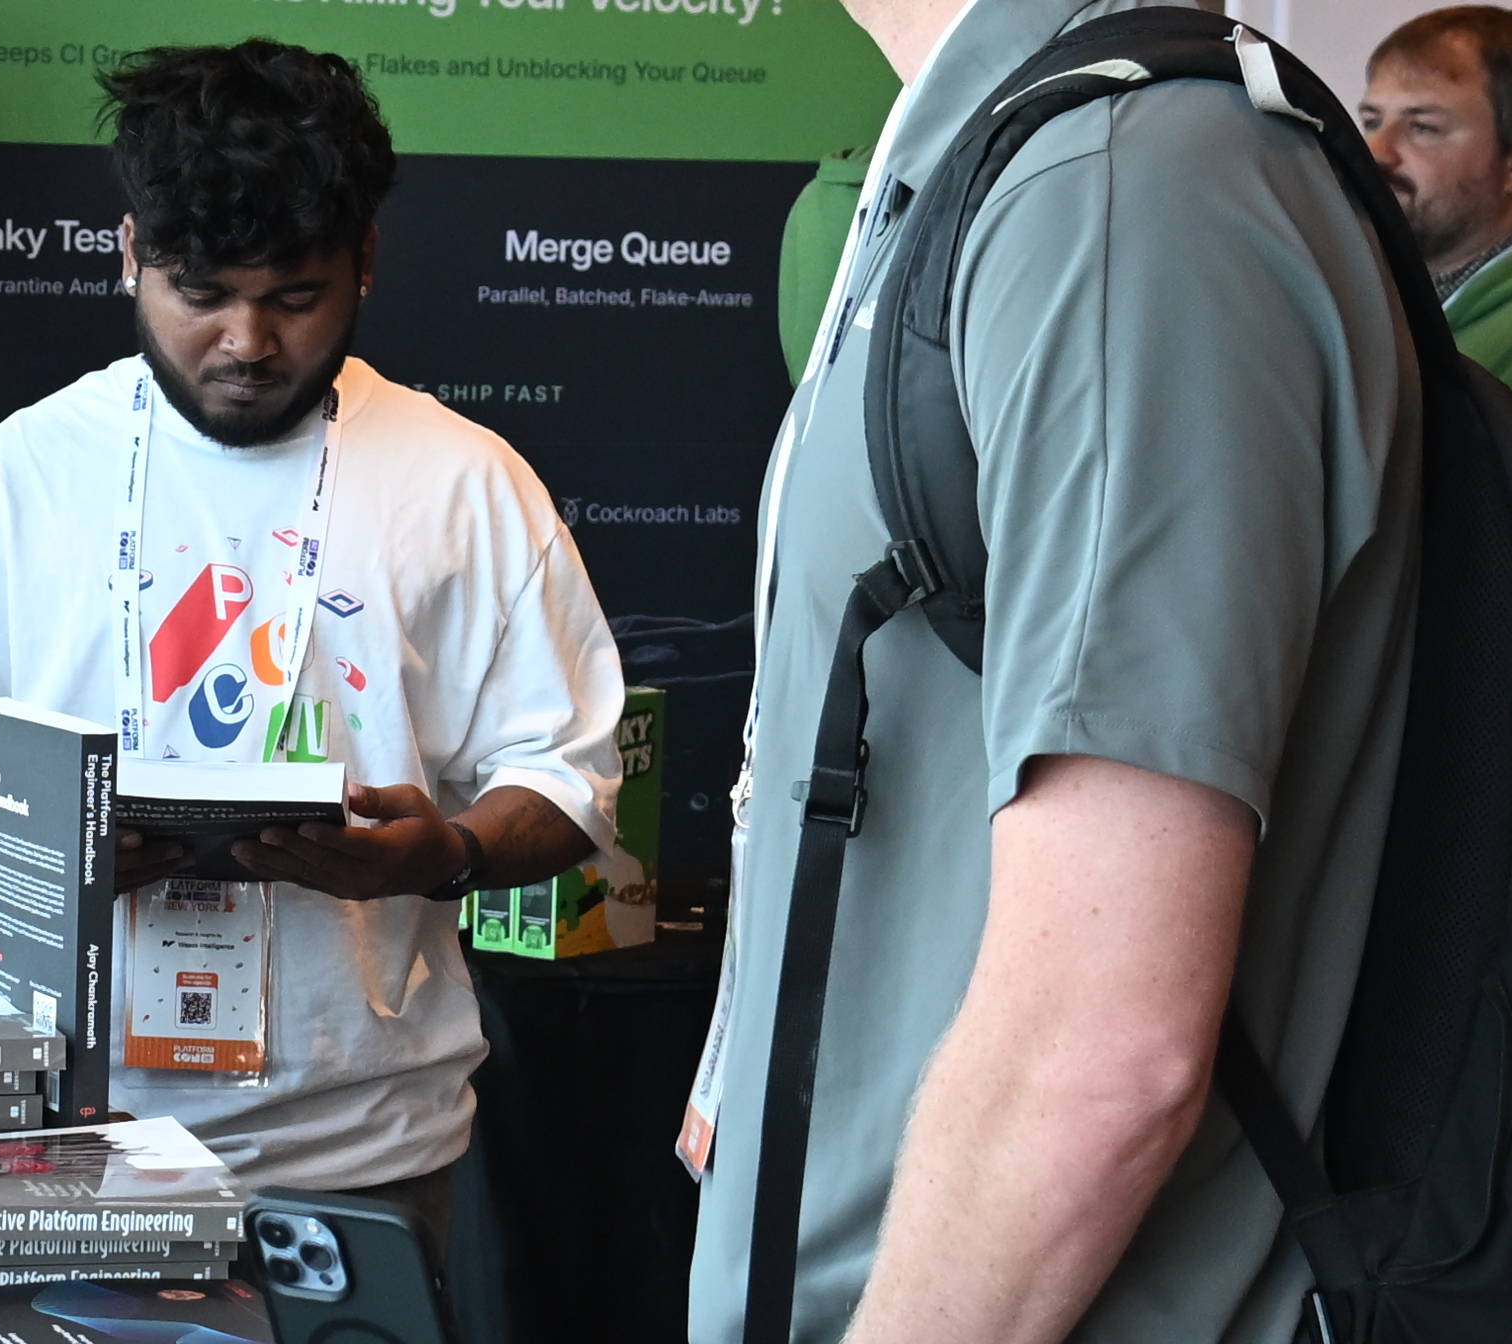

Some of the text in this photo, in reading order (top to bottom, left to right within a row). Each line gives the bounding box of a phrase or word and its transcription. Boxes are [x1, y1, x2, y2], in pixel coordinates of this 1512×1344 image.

[60, 42, 85, 65] CI
[365, 53, 767, 85] Flakes and Unblocking Your Queue
[55, 219, 125, 253] Test
[505, 229, 732, 272] Merge Queue
[69, 278, 108, 296] And
[478, 285, 754, 309] Parallel, Batched, Flake-Aware
[437, 384, 565, 404] SHIP FAST
[585, 502, 742, 525] Cockroach Labs
[100, 754, 112, 836] The Platform
[85, 755, 98, 885] Engineer's Handbook
[87, 944, 98, 1048] Ajay Chankramath
[29, 1210, 97, 1232] Platform
[101, 1210, 193, 1237] Engineering
